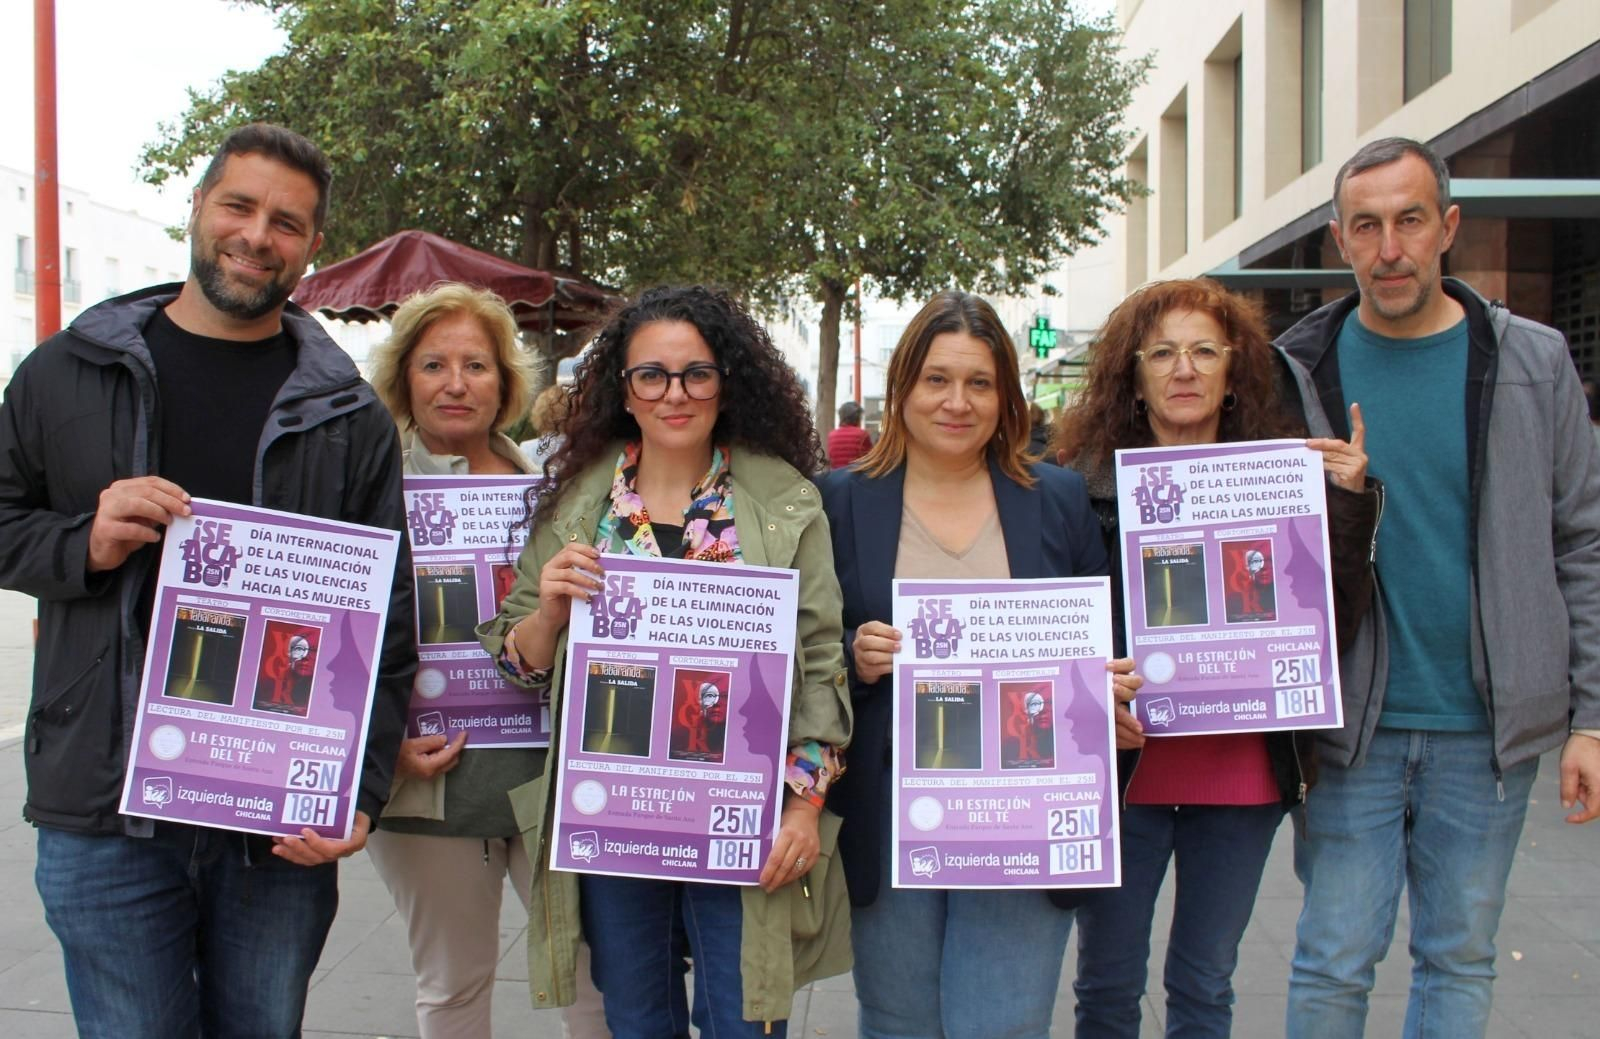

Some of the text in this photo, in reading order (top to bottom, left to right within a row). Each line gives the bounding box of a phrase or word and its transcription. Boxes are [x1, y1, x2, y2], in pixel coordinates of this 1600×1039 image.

[1189, 458, 1308, 474] DÍA INTERNACIONAL
[1140, 466, 1172, 486] ¡SE
[1190, 472, 1304, 489] DE LA ELIMINACIÓN
[413, 492, 445, 511] ¡SE
[460, 490, 479, 502] DÍA
[1135, 484, 1184, 506] ACA
[1191, 489, 1304, 504] DE LAS VIOLENCIAS
[408, 510, 456, 529] ACA
[462, 508, 492, 516] DE LA
[1140, 504, 1180, 524] BO!
[1192, 504, 1310, 520] HACIA LAS MUJERES
[192, 519, 232, 545] ¡SE
[462, 522, 476, 530] DE
[480, 521, 500, 530] LAS
[250, 527, 379, 560] DÍA INTERNACIONAL
[414, 528, 452, 546] BO!
[464, 536, 498, 544] HACIA
[181, 539, 238, 568] ACA
[247, 546, 372, 576] DE LA ELIMINACIÓN
[183, 561, 231, 587] BO!
[244, 563, 367, 592] DE LAS VIOLENCIAS
[241, 580, 370, 610] HACIA LAS MUJERES
[653, 577, 780, 600] DÍA INTERNACIONAL
[590, 594, 642, 620] ACA
[652, 596, 774, 616] DE LA ELIMINACIÓN
[918, 599, 952, 619] ¡SE
[970, 597, 1094, 610] DÍA INTERNACIONAL
[592, 616, 637, 640] BO!
[650, 614, 772, 634] DE LAS VIOLENCIAS
[970, 612, 1089, 626] DE LA ELIMINACIÓN
[911, 618, 962, 640] ACA
[970, 630, 1088, 642] DE LAS VIOLENCIAS
[648, 632, 777, 651] HACIA LAS MUJERES
[916, 638, 958, 659] BO!
[1267, 642, 1320, 652] CHICLANA
[970, 646, 1096, 658] HACIA LAS MUJERES
[1178, 648, 1256, 664] LA ESTACIÓN
[450, 670, 464, 680] LA
[1199, 660, 1237, 674] DEL TÉ
[1275, 658, 1316, 684] 25N
[470, 680, 490, 690] DEL
[1178, 700, 1267, 718] izquierda unida
[1282, 690, 1318, 714] 18H
[197, 711, 216, 721] DEL
[448, 716, 498, 730] izquierda
[501, 714, 532, 726] unida
[190, 732, 276, 754] LA ESTACIÓN
[289, 741, 346, 757] CHICLANA
[210, 747, 253, 764] DEL TÉ
[290, 760, 336, 791] 25N
[616, 764, 634, 772] DEL
[177, 786, 274, 812] izquierda unida
[612, 785, 696, 802] LA ESTACIÓN
[709, 788, 765, 800] CHICLANA
[1044, 791, 1101, 801] CHICLANA
[290, 794, 330, 824] 18H
[632, 799, 673, 814] DEL TÉ
[948, 796, 1031, 810] LA ESTACIÓN
[235, 810, 271, 821] CHICLANA
[712, 806, 758, 834] 25N
[968, 810, 1010, 822] DEL TÉ
[1050, 809, 1094, 836] 25N
[604, 839, 698, 859] izquierda unida
[715, 841, 754, 868] 18H
[1056, 843, 1095, 870] 18H
[662, 860, 697, 868] CHICLANA
[944, 854, 1000, 869] izquierda
[1003, 852, 1040, 866] unida
[1004, 868, 1040, 876] CHICLANA
